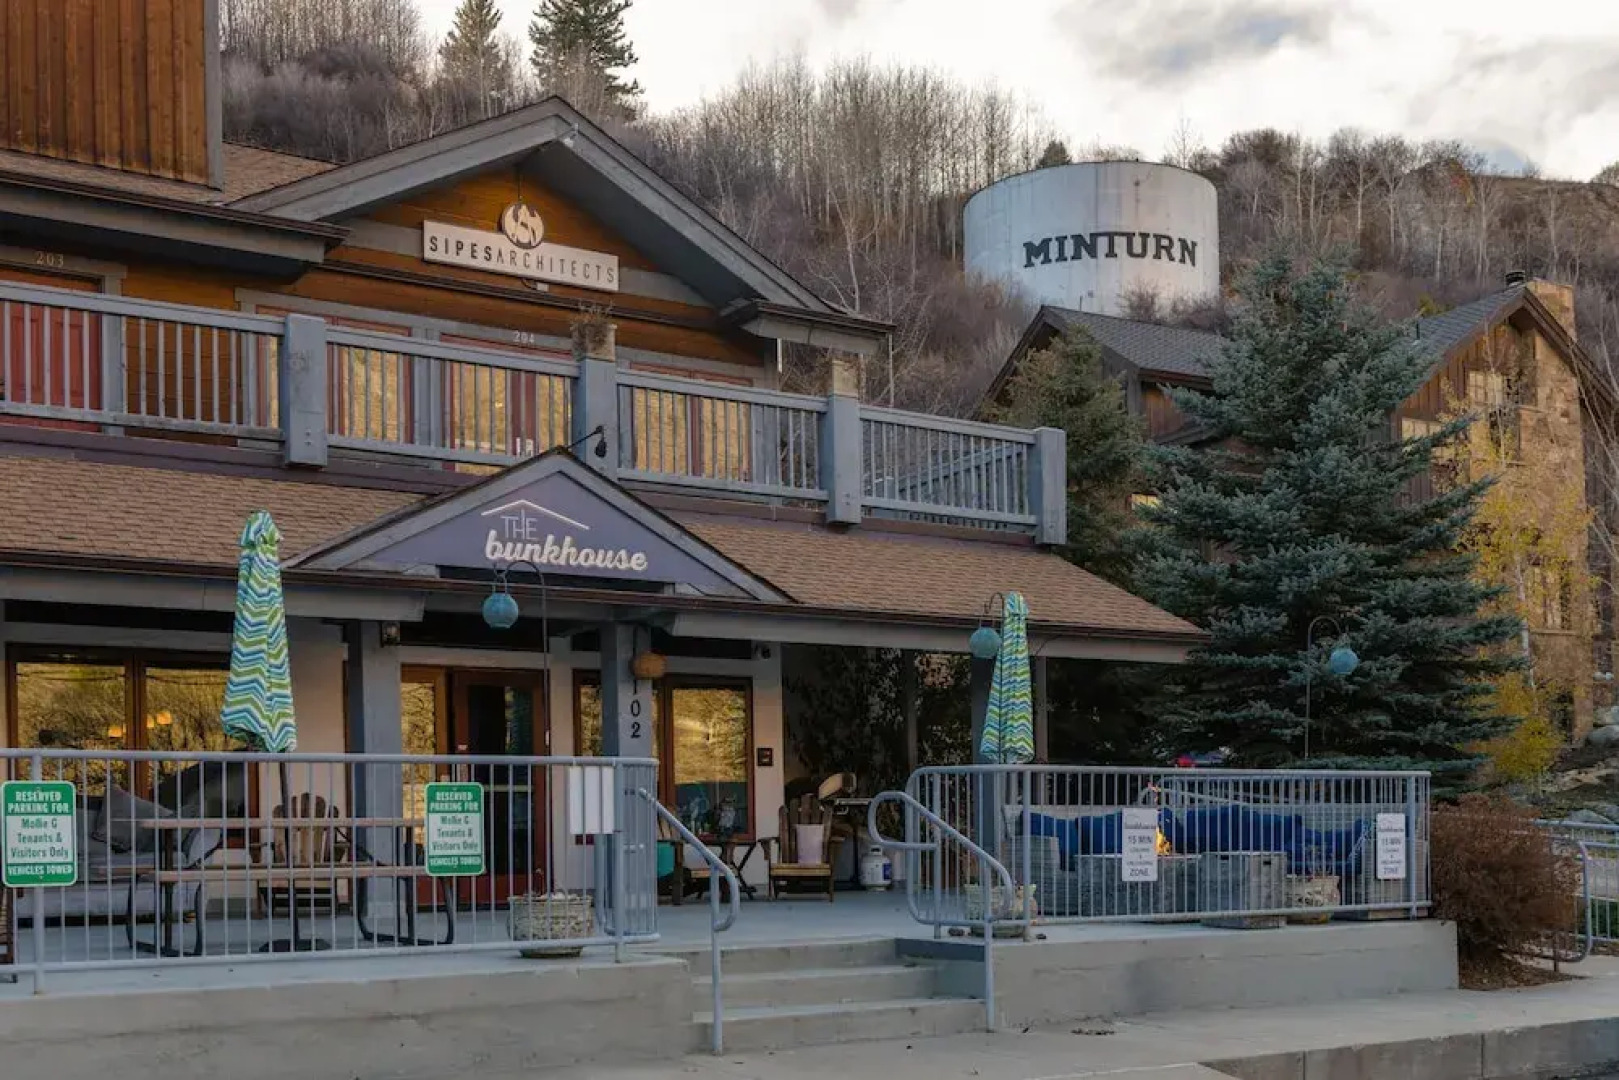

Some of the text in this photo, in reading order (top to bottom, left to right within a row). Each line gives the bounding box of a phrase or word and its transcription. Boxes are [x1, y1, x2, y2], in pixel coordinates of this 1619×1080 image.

[1022, 231, 1197, 269] MINTURN
[36, 251, 63, 268] 203
[501, 510, 538, 540] THE
[485, 530, 648, 571] bunkhouse
[630, 677, 641, 739] 102
[15, 791, 62, 802] RESERVED
[436, 791, 473, 801] RESERVED
[8, 802, 69, 813] PARKING FOR
[430, 801, 479, 811] PARKING FOR
[17, 832, 53, 844] Tenants
[11, 846, 68, 860] Visitors Only
